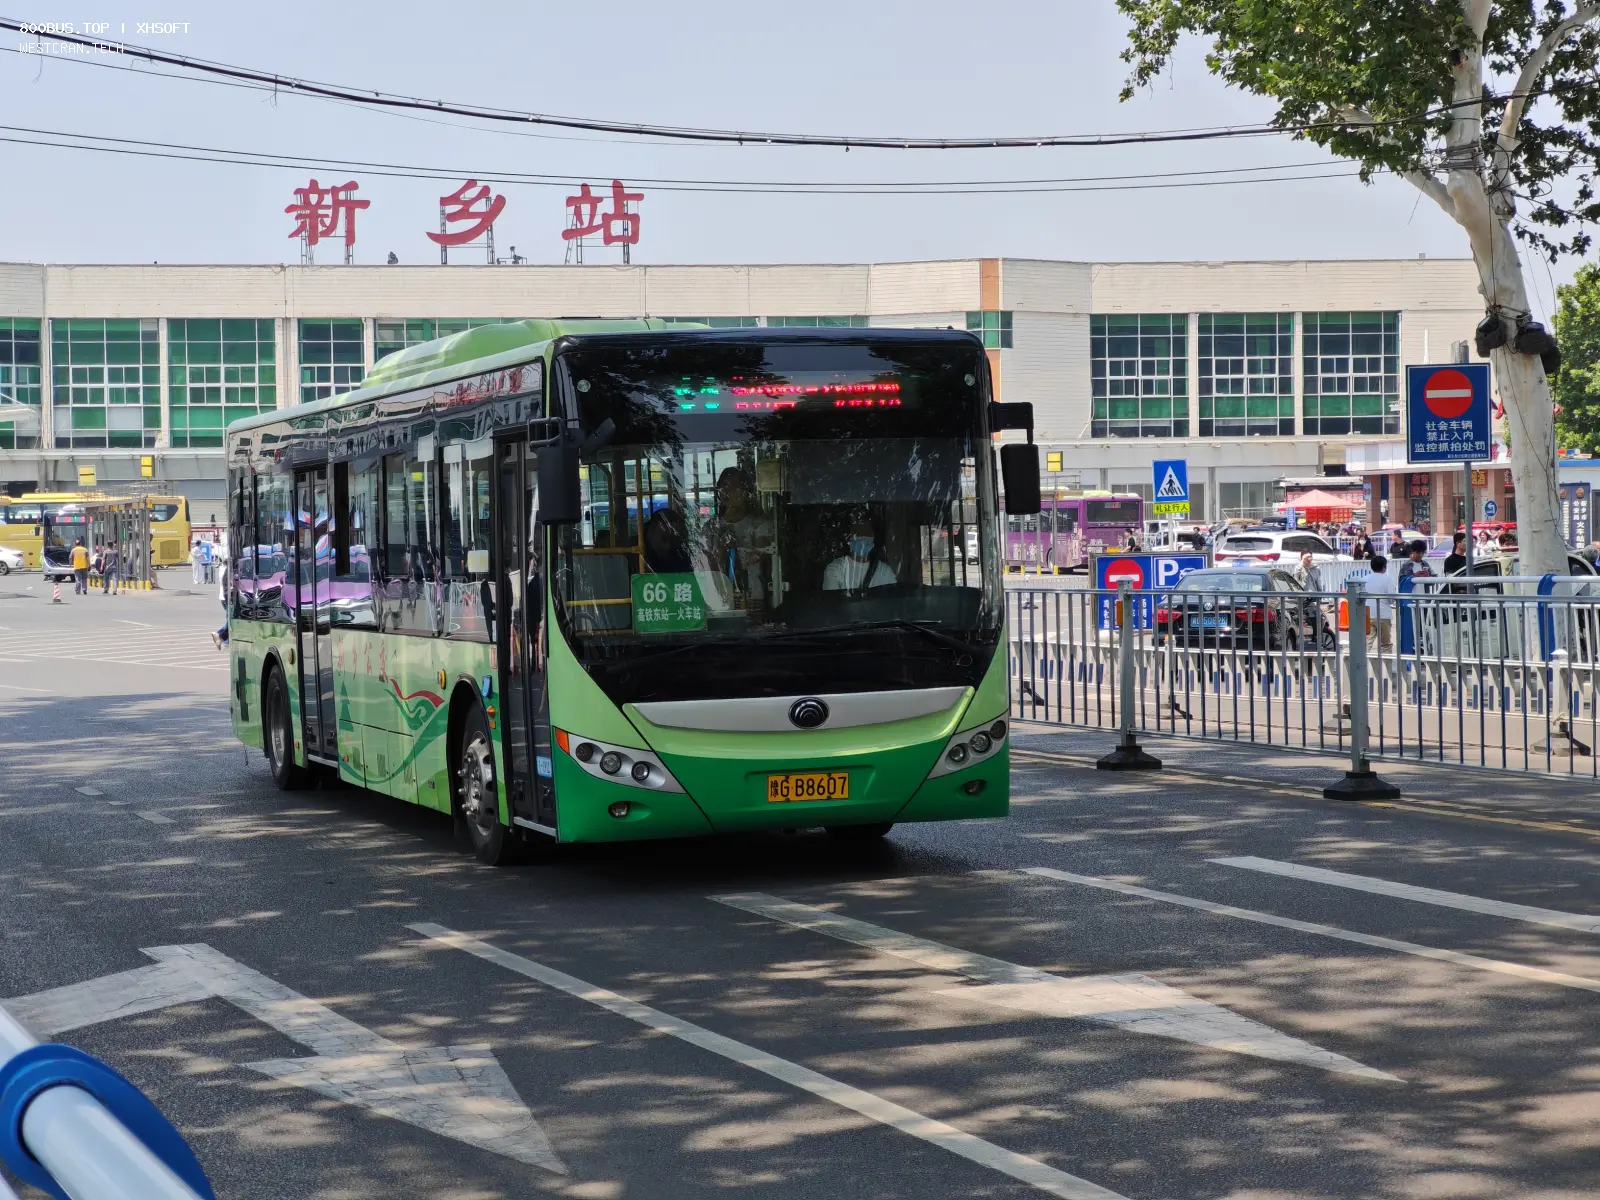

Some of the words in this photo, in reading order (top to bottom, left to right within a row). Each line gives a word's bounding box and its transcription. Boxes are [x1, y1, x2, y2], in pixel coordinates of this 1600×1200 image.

[285, 179, 645, 246] 新乡站
[1425, 420, 1473, 431] 社会车辆
[1426, 431, 1474, 442] 禁止入内
[1414, 441, 1486, 453] 监控抓拍处罚
[1155, 503, 1189, 513] 礼让行人
[1158, 559, 1179, 586] P
[643, 582, 667, 603] 66
[674, 582, 692, 602] 路
